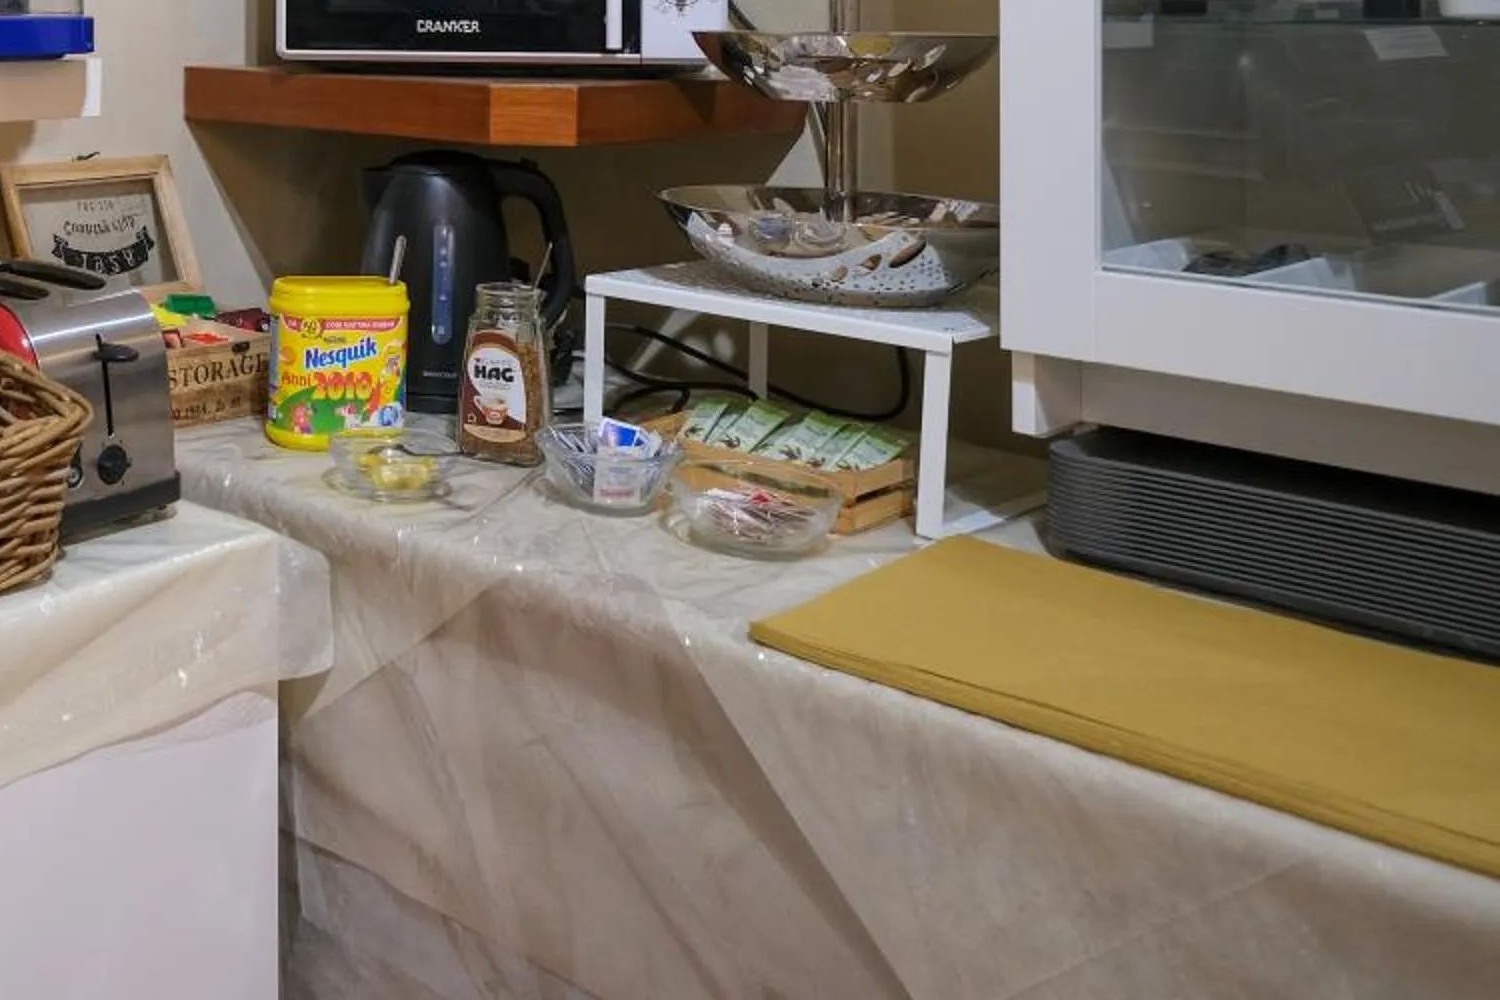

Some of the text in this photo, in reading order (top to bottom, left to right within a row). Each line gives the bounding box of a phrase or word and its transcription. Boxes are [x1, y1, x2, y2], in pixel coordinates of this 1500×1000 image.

[416, 19, 481, 33] CRANKER
[305, 336, 377, 369] Nesquik
[474, 365, 515, 382] HAG
